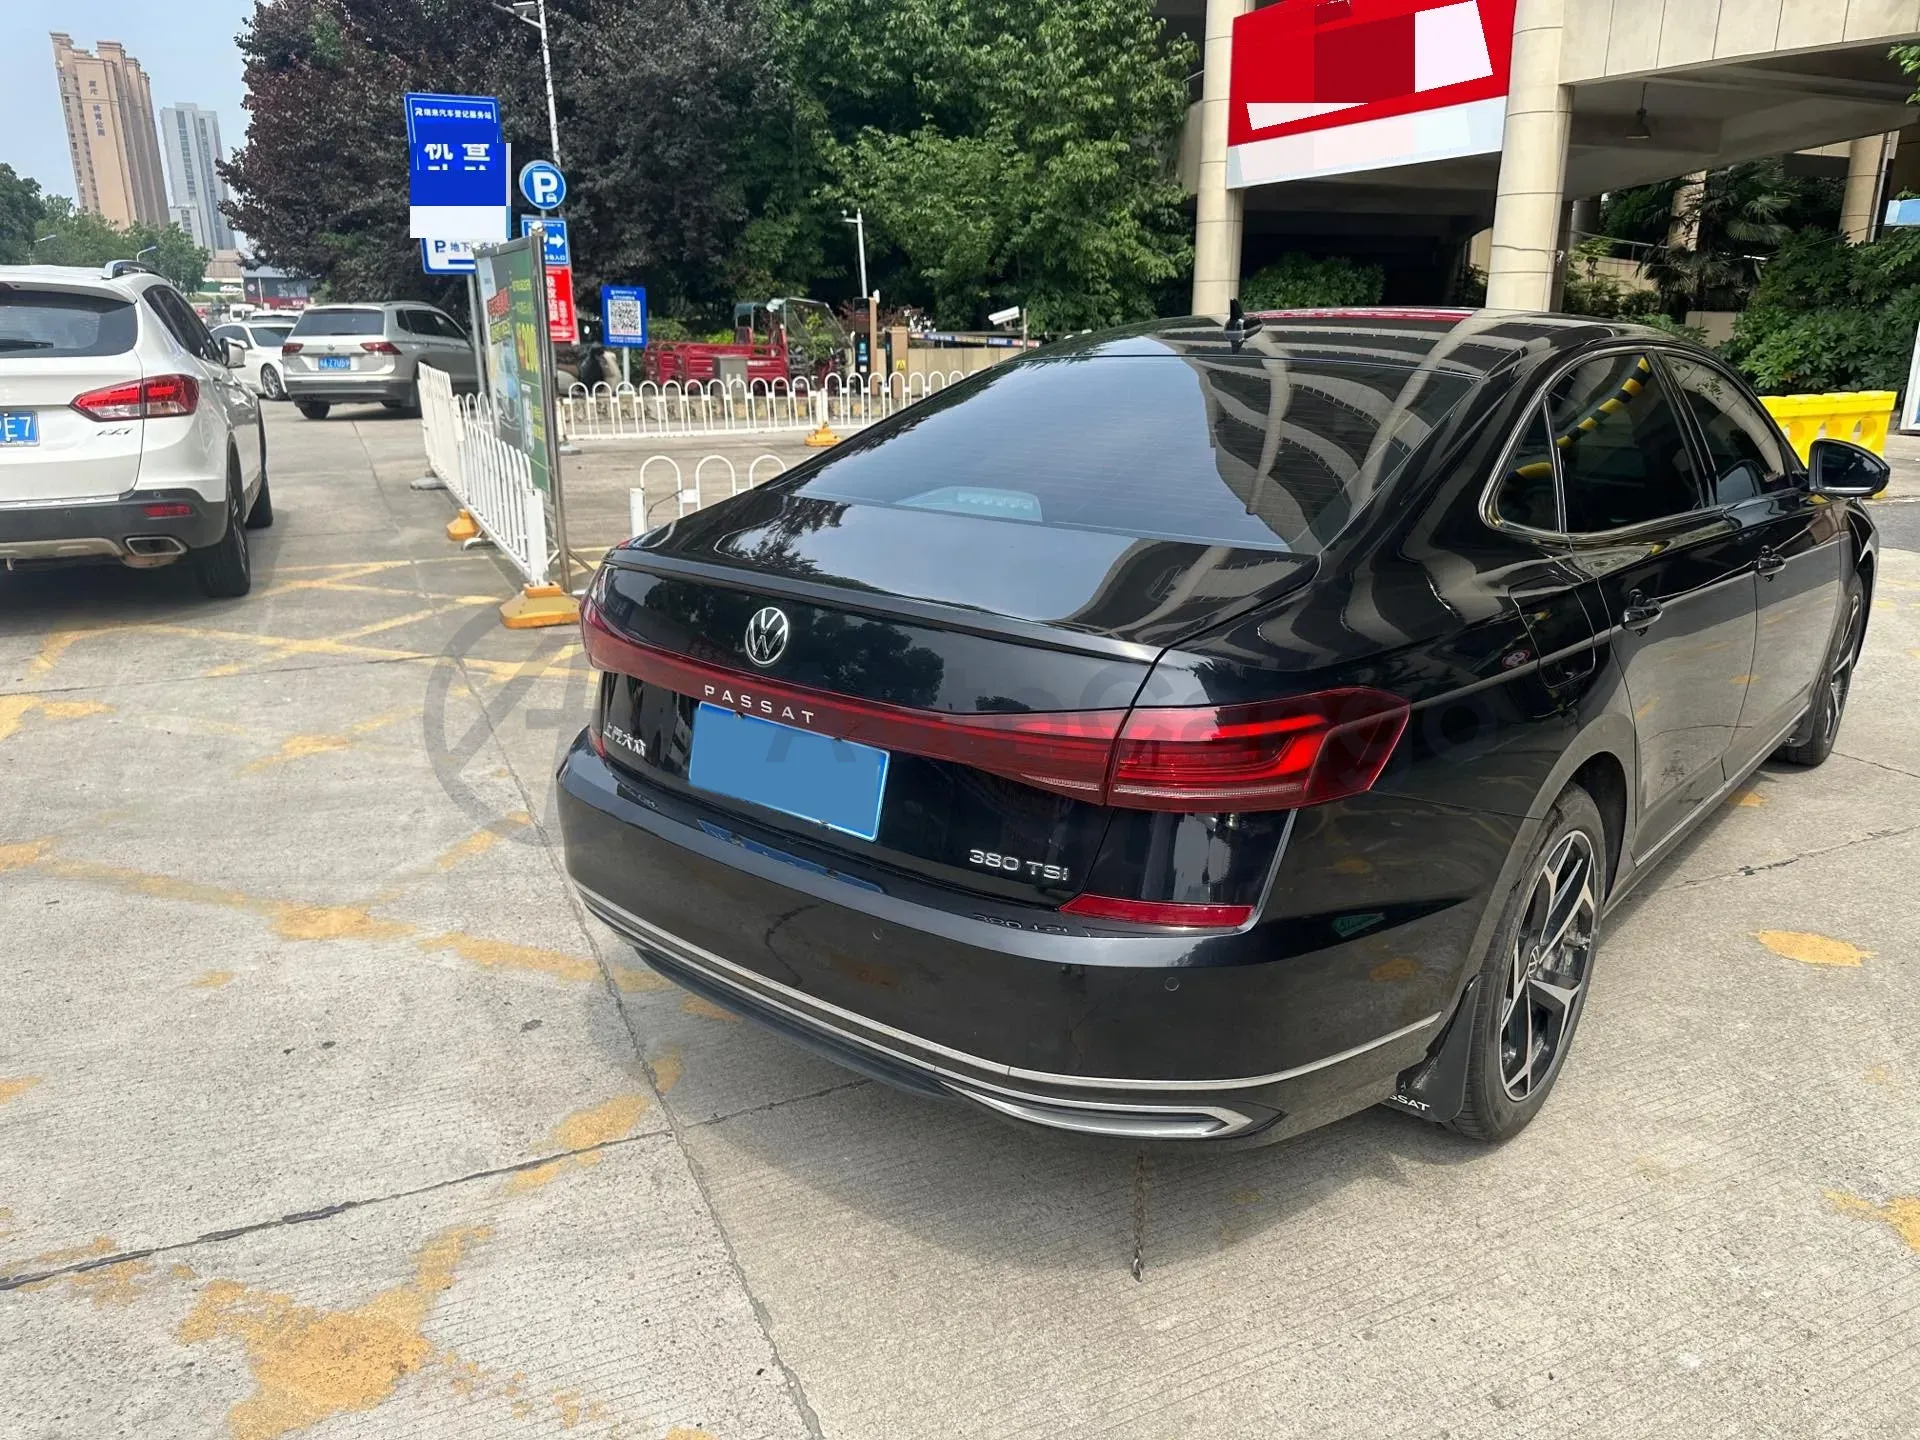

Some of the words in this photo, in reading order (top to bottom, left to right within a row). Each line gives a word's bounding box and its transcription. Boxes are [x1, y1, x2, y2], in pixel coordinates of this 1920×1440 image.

[0, 416, 32, 439] E7
[703, 684, 815, 724] PASSAT
[603, 721, 647, 758] 上汽大众
[968, 848, 1020, 871] 380
[1025, 860, 1069, 881] TSI
